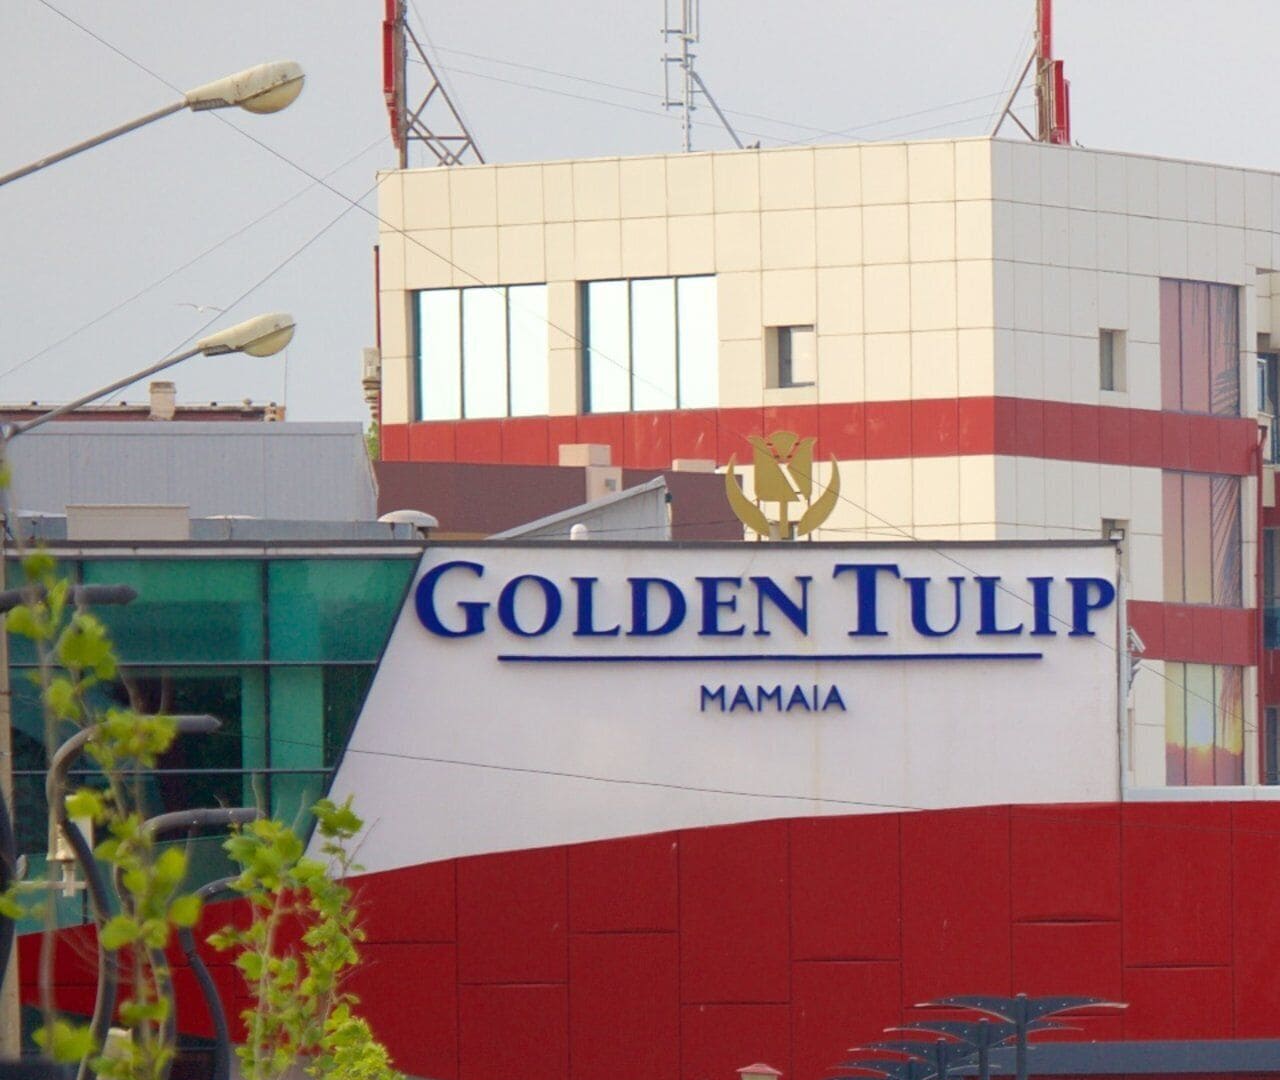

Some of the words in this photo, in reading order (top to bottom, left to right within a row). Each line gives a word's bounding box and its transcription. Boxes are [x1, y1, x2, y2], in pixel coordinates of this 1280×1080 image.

[414, 560, 812, 638] GOLDEN
[833, 563, 1116, 638] TULIP
[700, 684, 847, 713] MAMAIA
